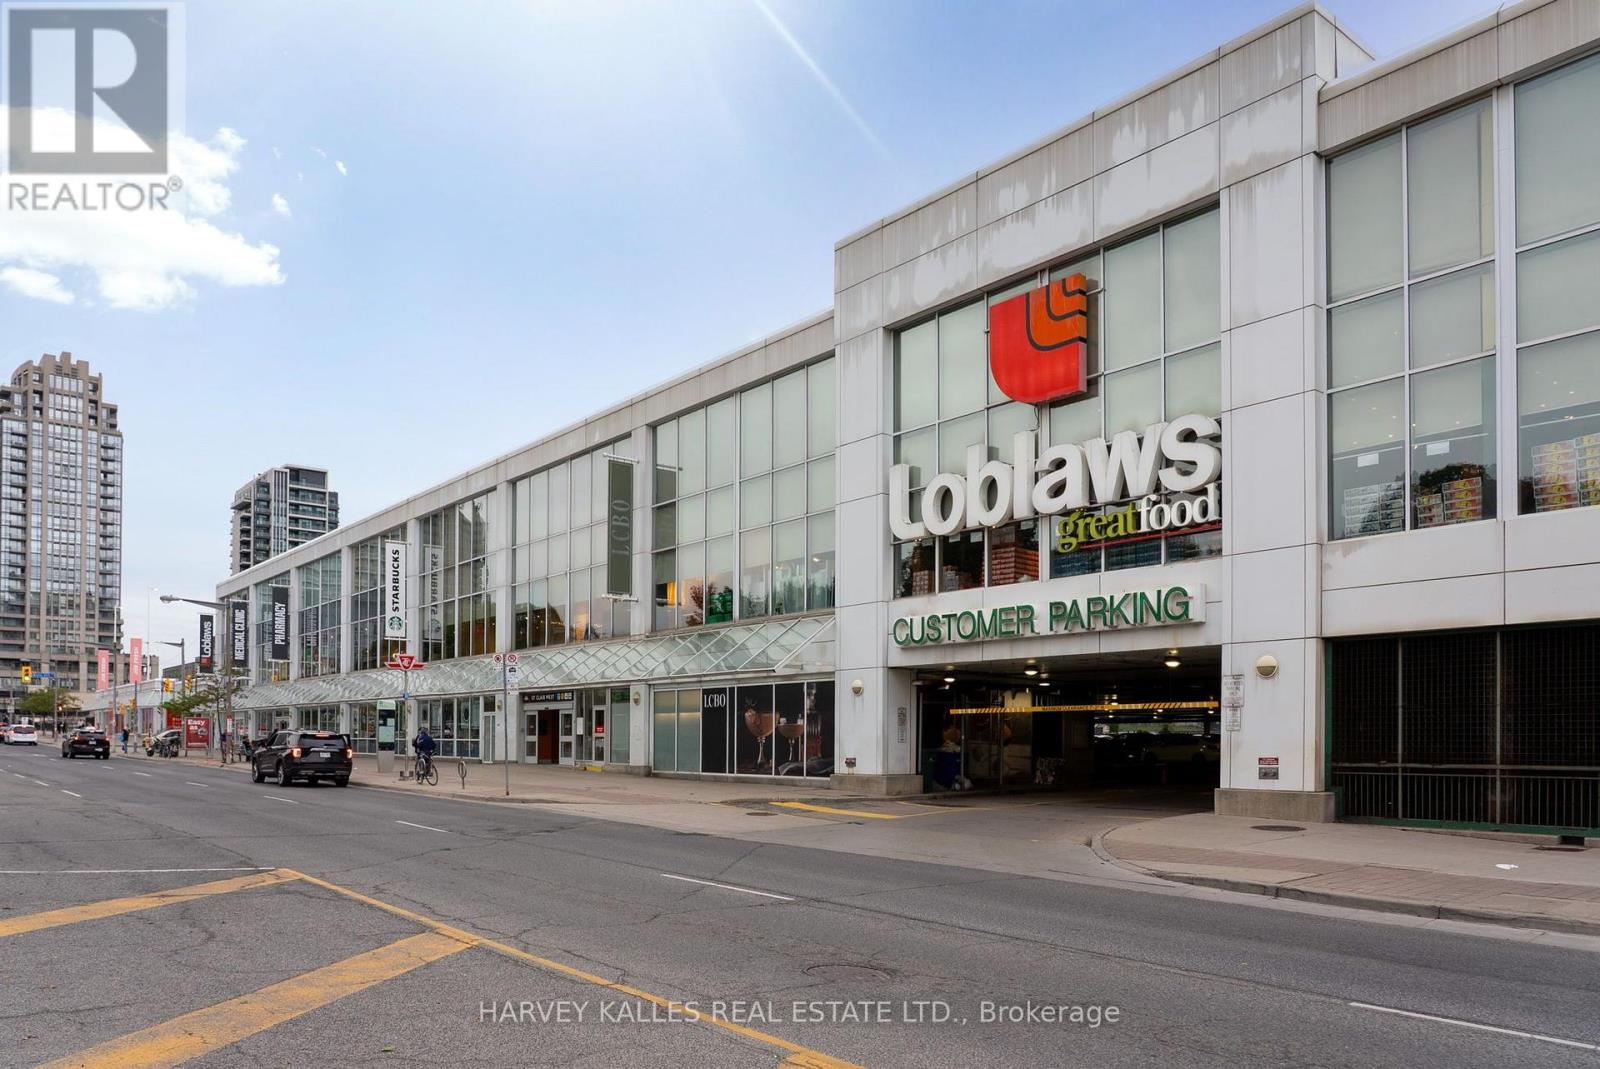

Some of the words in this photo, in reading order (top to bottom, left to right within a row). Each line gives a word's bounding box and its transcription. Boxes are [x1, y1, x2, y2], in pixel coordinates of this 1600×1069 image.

[888, 413, 1222, 541] Loblaws
[610, 498, 631, 556] LCBO
[391, 548, 401, 613] STARBUCKS
[234, 609, 245, 631] CLINIC
[274, 601, 286, 645] PHARMACY
[893, 604, 1035, 646] CUSTOMER
[1048, 585, 1193, 631] PARKING
[201, 620, 212, 658] Loblaws
[234, 631, 245, 661] MEDICAL
[704, 693, 727, 708] LCBO
